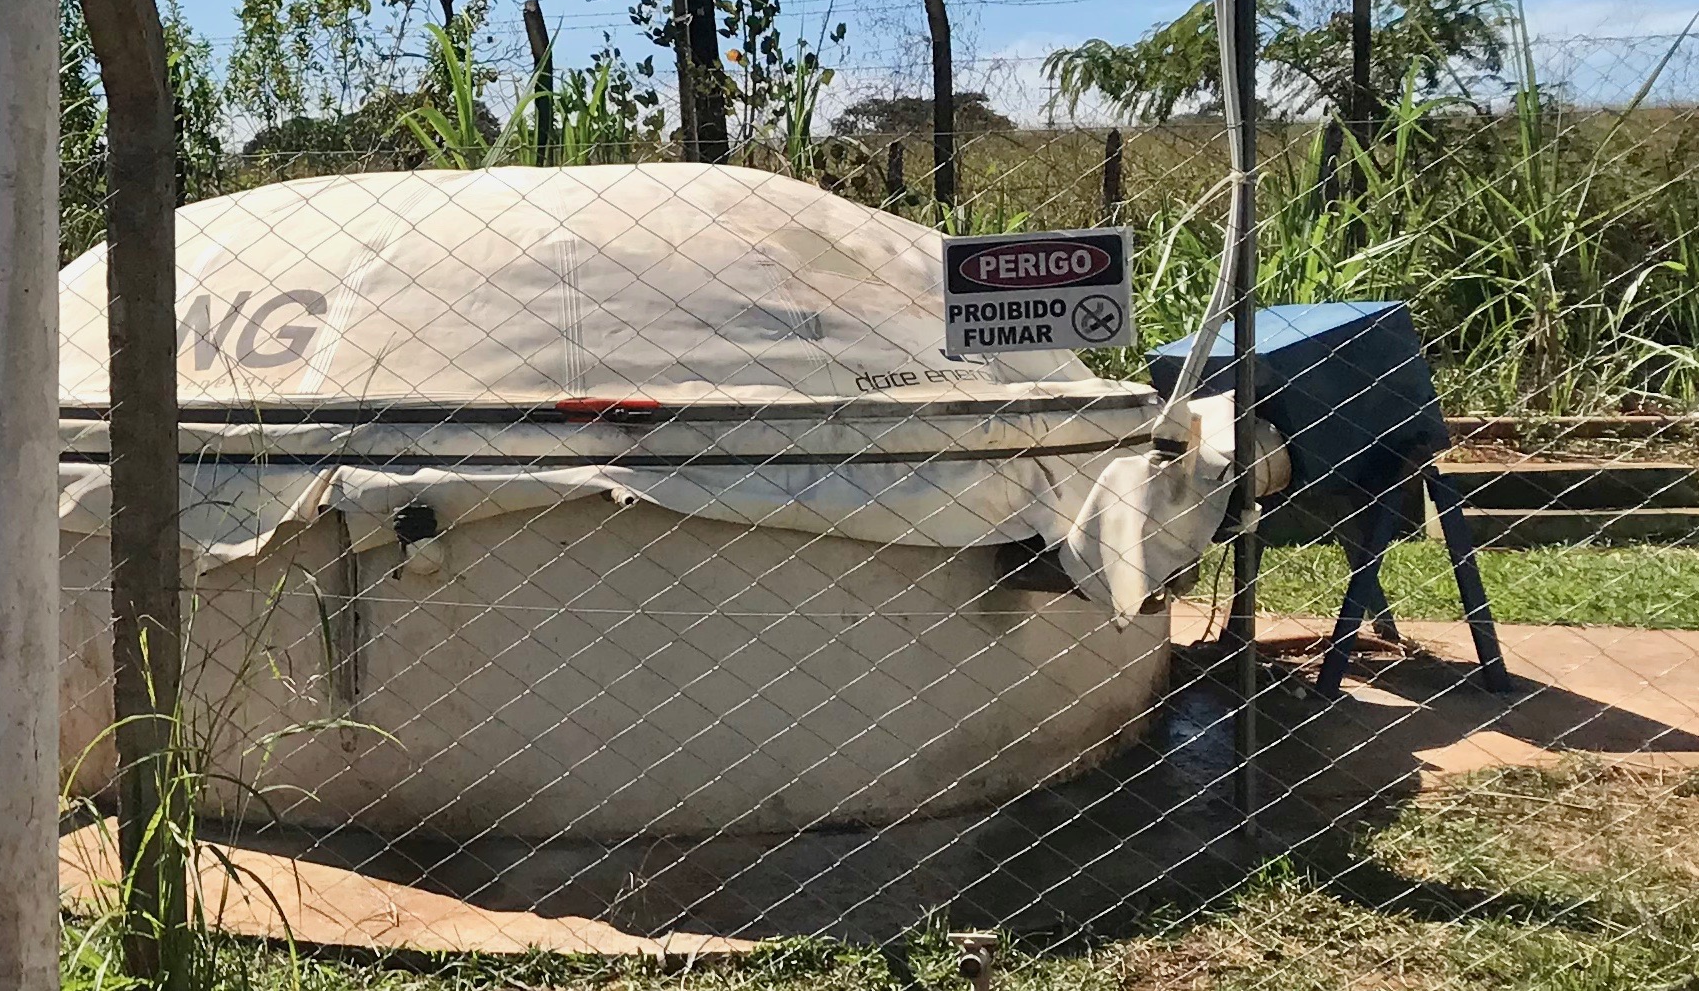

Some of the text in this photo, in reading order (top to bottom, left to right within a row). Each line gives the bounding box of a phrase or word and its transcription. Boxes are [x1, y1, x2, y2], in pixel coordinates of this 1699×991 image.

[978, 249, 1092, 280] PERIGO
[949, 298, 1067, 324] PROIBIDO
[964, 324, 1053, 348] FUMAR
[924, 369, 1000, 385] energ
